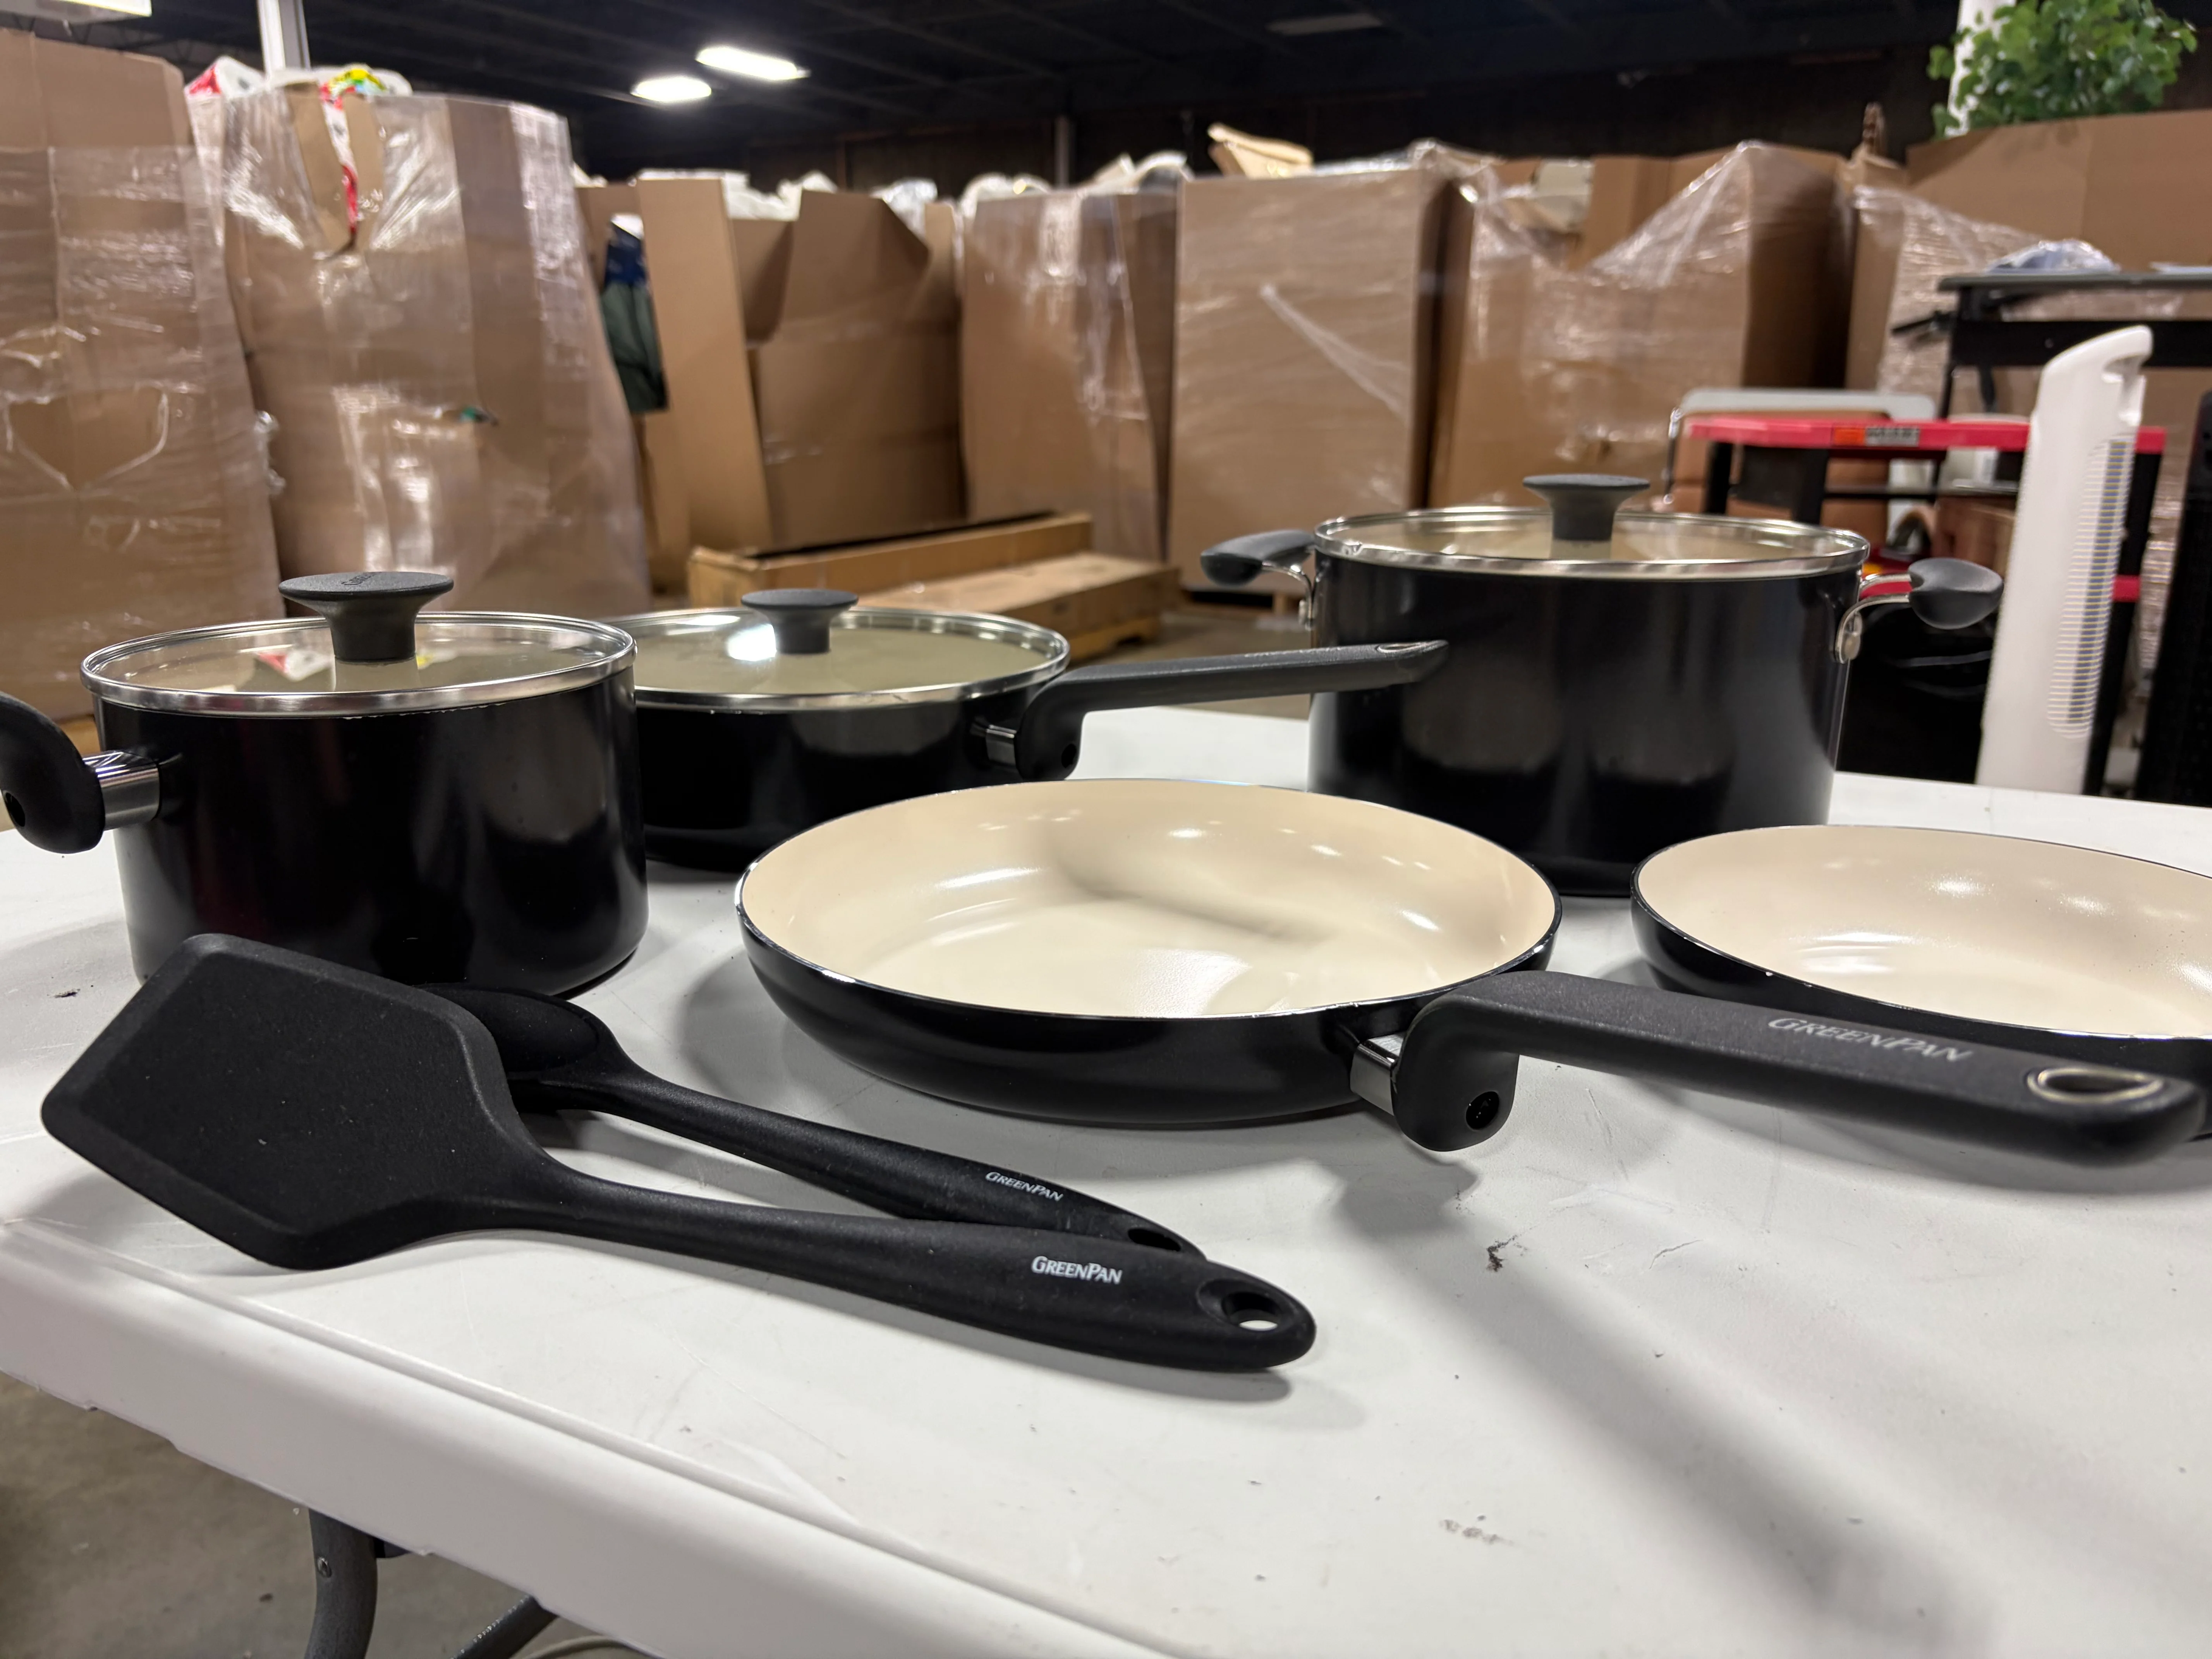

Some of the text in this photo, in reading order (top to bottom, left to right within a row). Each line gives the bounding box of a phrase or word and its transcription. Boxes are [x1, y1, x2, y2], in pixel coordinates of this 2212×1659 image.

[1768, 1018, 1973, 1062] GREENPAN
[985, 1171, 1064, 1201] GREENPAN
[1031, 1255, 1123, 1285] GREENPAN
